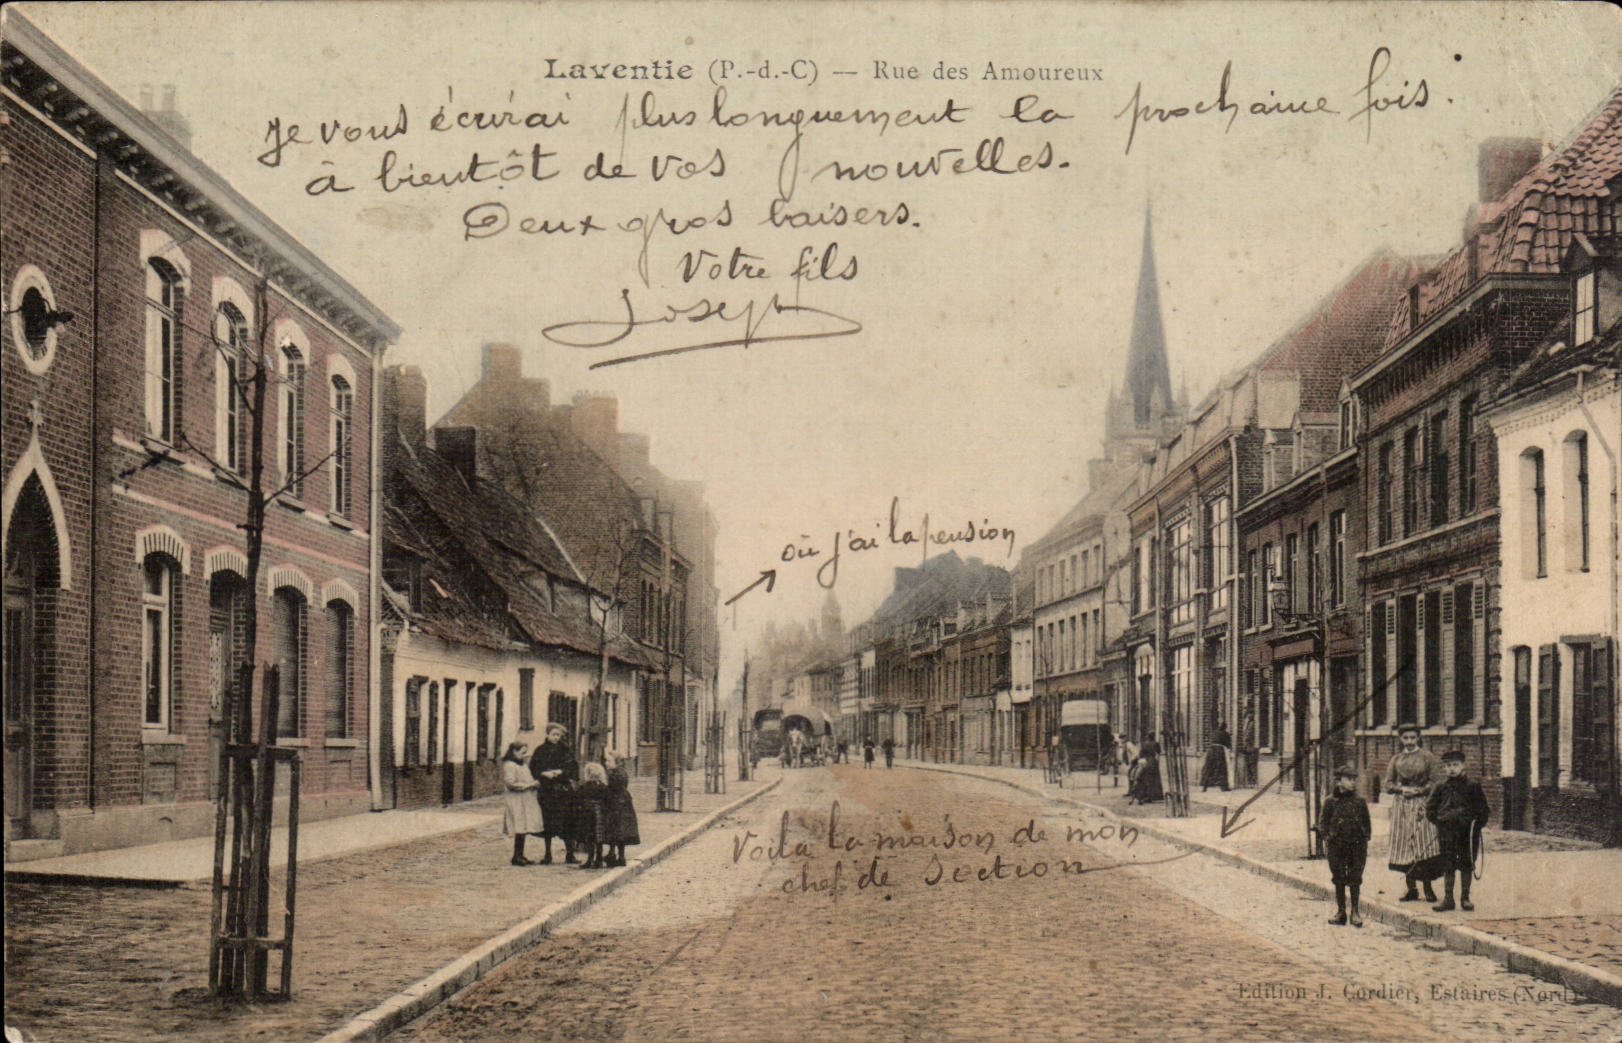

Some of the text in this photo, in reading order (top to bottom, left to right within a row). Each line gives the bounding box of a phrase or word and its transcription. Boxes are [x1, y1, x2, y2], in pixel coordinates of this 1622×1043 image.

[320, 103, 408, 145] vous
[616, 91, 696, 164] plus
[712, 85, 970, 201] longuement
[1000, 94, 1074, 125] la
[1113, 59, 1341, 156] prochaine
[374, 142, 560, 193] bientôt
[583, 152, 637, 182] de
[463, 201, 607, 242] Deux
[617, 199, 732, 289] gros
[789, 241, 859, 313] fils
[919, 511, 1016, 572] pension
[828, 799, 865, 852] la
[875, 813, 996, 856] maison
[1011, 817, 1049, 848] de
[1066, 823, 1140, 849] mon
[857, 856, 902, 891] de
